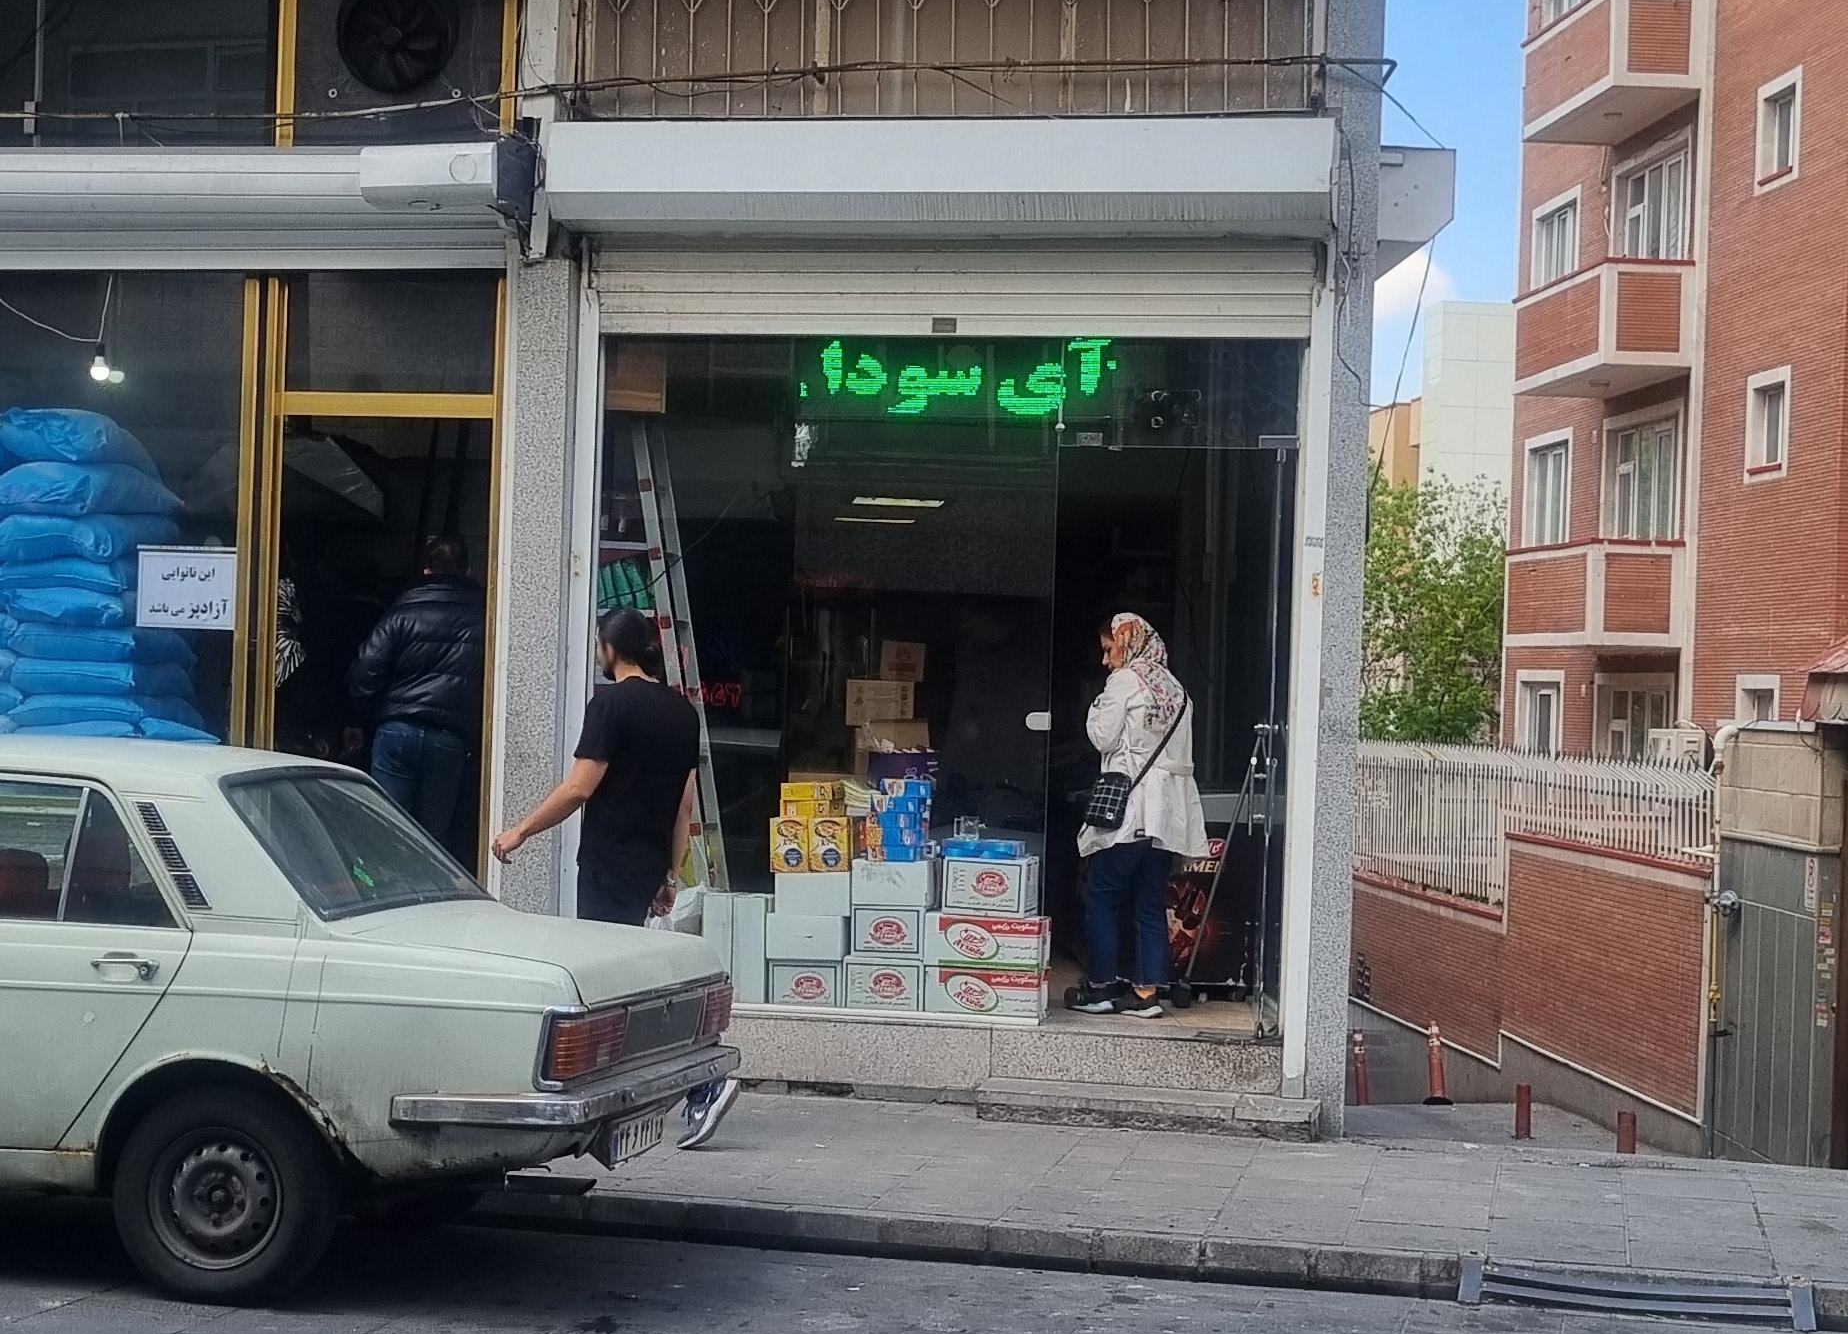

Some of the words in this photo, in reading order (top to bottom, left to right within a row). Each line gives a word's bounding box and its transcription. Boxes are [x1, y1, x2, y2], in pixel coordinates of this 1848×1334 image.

[821, 340, 982, 414] سودا
[998, 337, 1111, 415] آی
[161, 566, 197, 581] نانوایی
[198, 567, 215, 581] این
[149, 603, 170, 616] باشد
[171, 607, 185, 617] می
